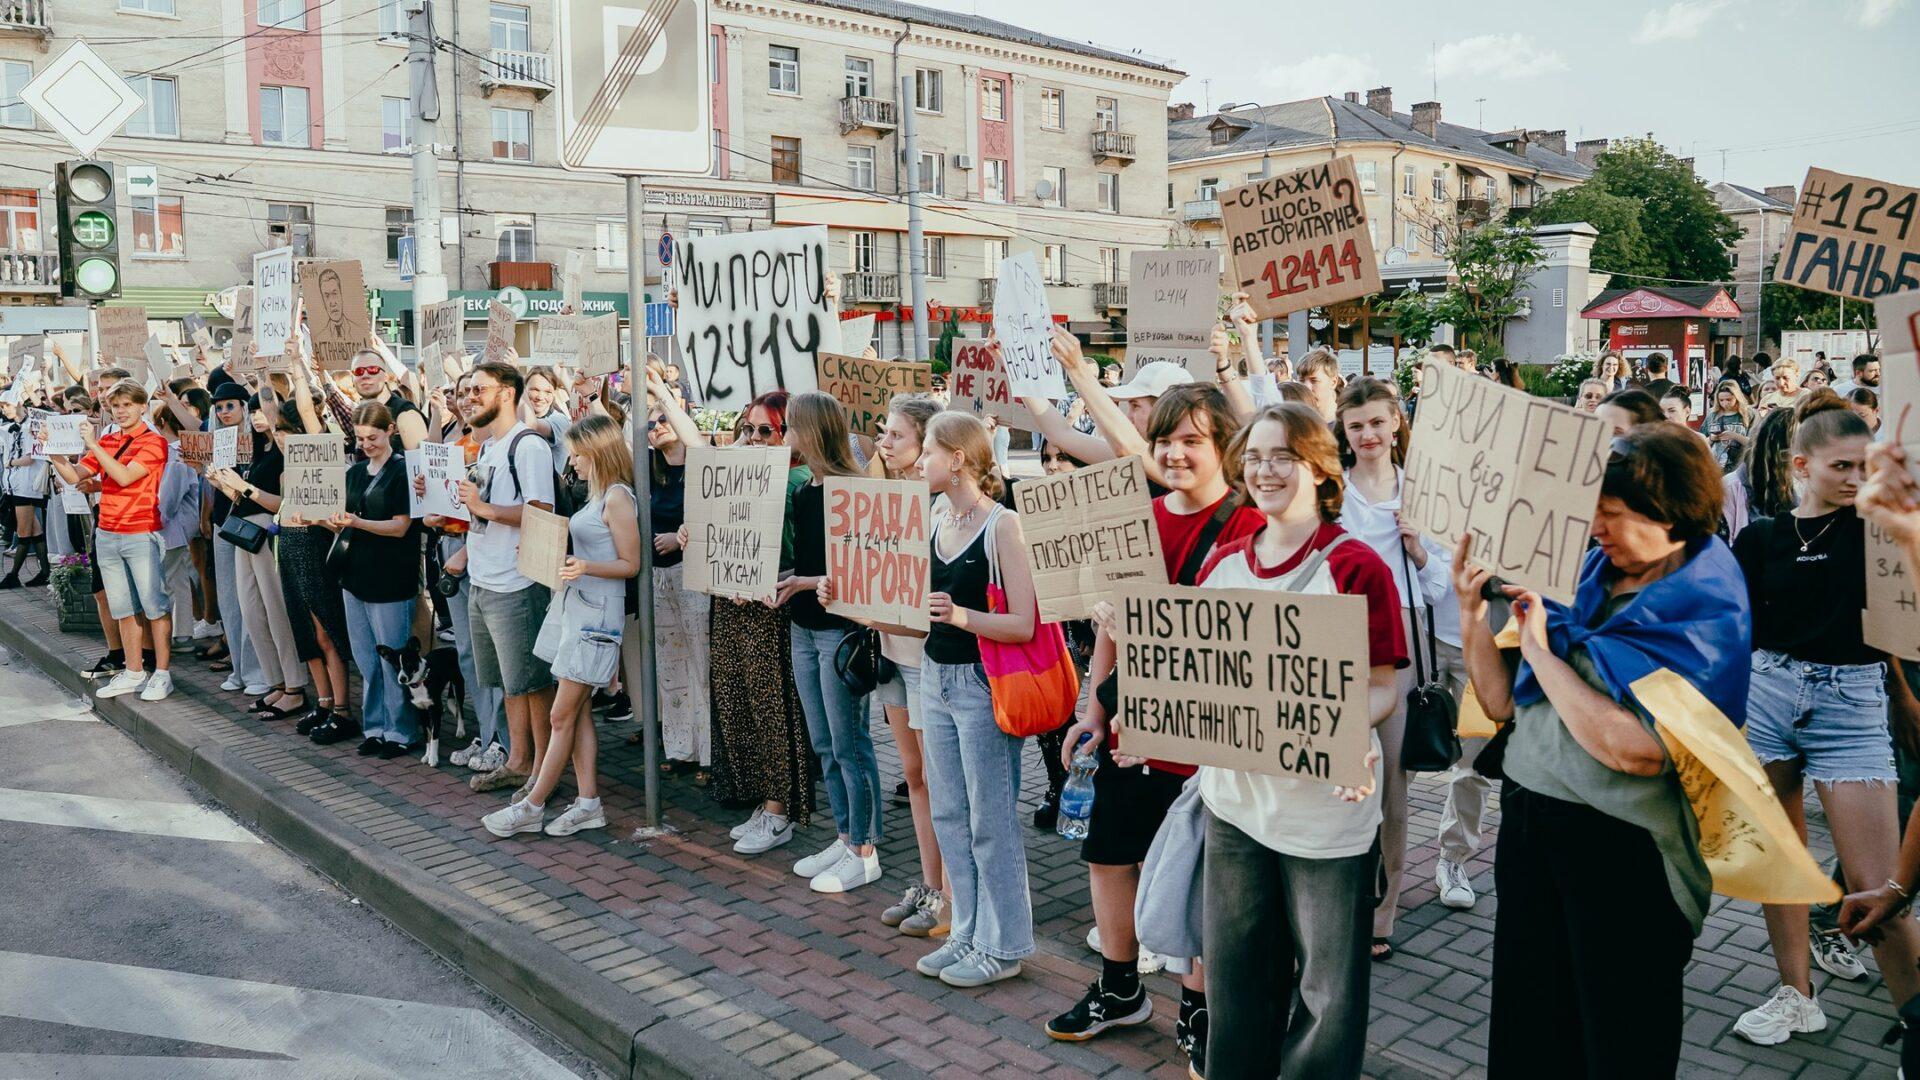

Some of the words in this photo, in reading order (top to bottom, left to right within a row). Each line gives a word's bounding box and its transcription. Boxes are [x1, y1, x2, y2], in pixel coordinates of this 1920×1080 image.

[1261, 196, 1322, 226] ЩОСЬ
[79, 218, 108, 241] 33
[261, 261, 288, 288] 12414
[729, 242, 828, 312] ПРОТИ
[1143, 261, 1170, 280] МИ
[1176, 258, 1212, 277] ПРОТИ
[261, 296, 288, 315] КРІНЖ
[1154, 288, 1188, 307] 12414
[263, 322, 287, 338] РОКУ
[686, 312, 821, 404] 12414
[822, 356, 927, 388] СКАСУЄТЕ
[955, 373, 976, 398] НЕ
[1416, 363, 1506, 450] РУКИ
[1516, 401, 1606, 487] ГЕТЬ
[289, 484, 339, 507] ЛІКВІДАЦІЯ
[701, 464, 772, 499] ОБЛИЧЧЯ
[1021, 461, 1139, 515] БОРІТЕСЯ
[830, 489, 924, 542] ЗРАДА
[1400, 449, 1479, 545] НАБУ
[1472, 526, 1495, 563] ТА
[1500, 497, 1590, 596] САП
[706, 523, 761, 564] ВЧИНКИ
[843, 531, 900, 552] #12414
[1031, 518, 1154, 571] ПОБОРЕТЕ!
[830, 542, 929, 609] НАРОДУ
[1125, 597, 1254, 642] HISTORY
[1275, 603, 1301, 650] IS
[1127, 643, 1253, 689] REPEATING
[1268, 653, 1355, 702] ITSELF
[1124, 695, 1264, 753] НЕЗАЛЕЖНІСТЬ
[1276, 700, 1342, 738] НАБУ
[1298, 733, 1313, 748] ТА
[1279, 741, 1331, 779] САП
